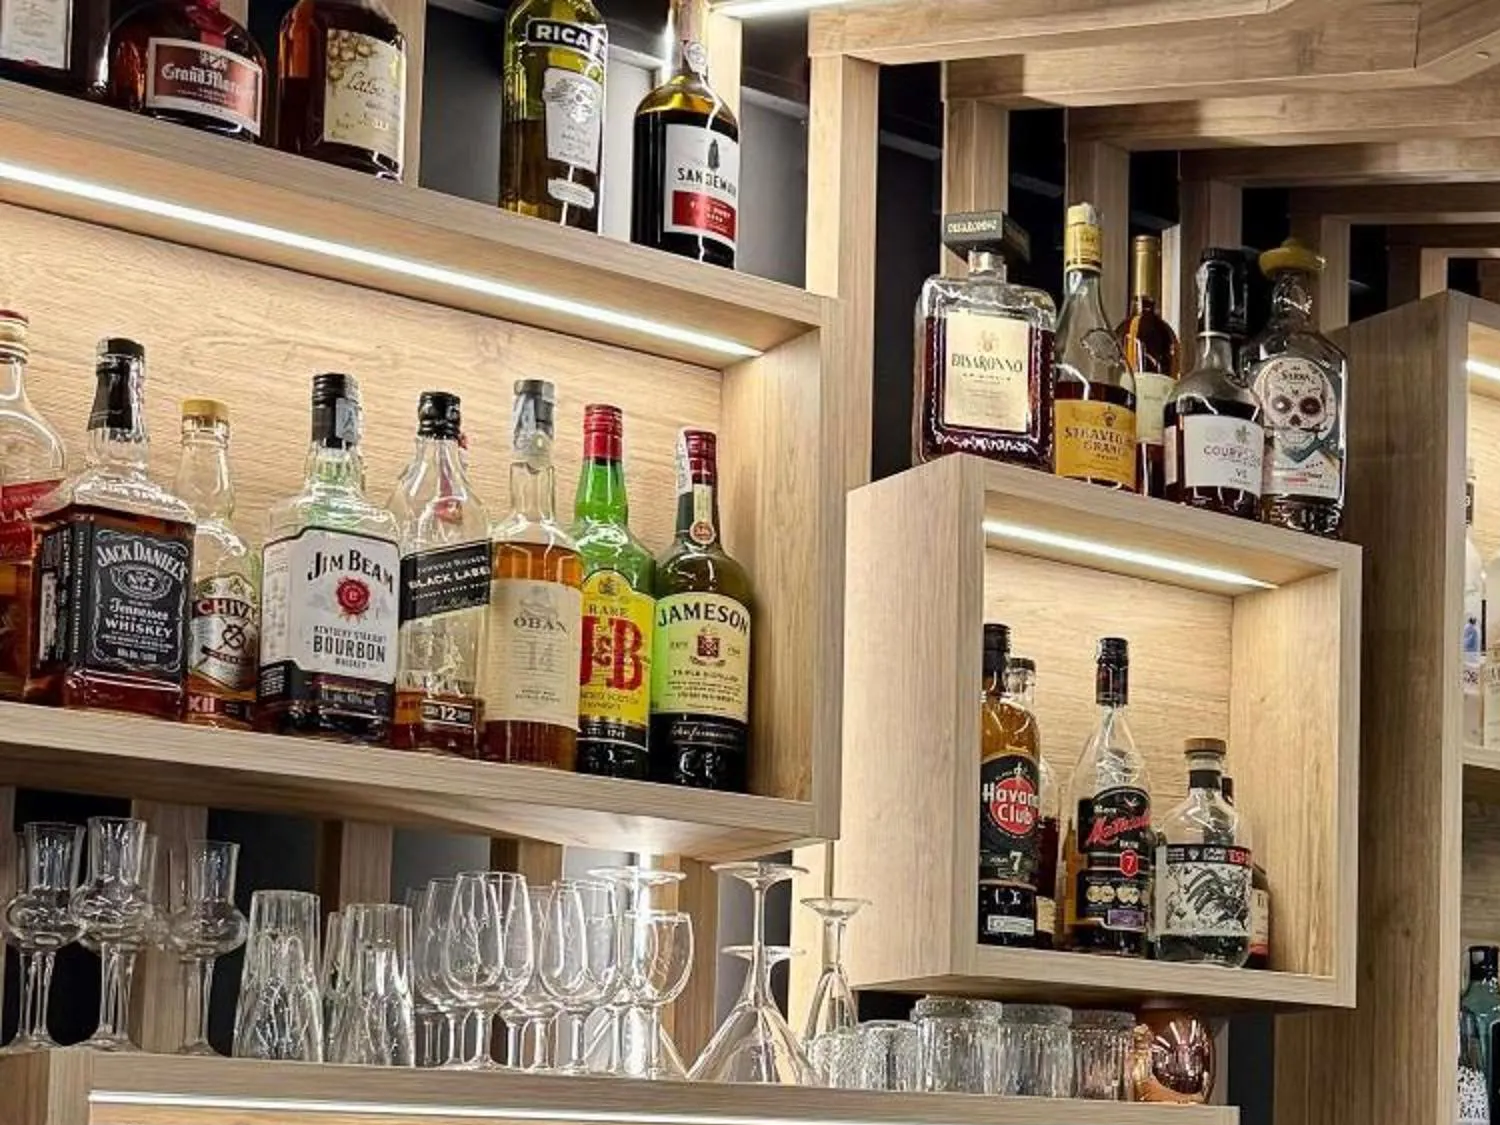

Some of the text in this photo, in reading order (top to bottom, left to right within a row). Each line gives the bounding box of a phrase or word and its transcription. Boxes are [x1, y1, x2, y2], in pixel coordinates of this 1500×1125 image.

[951, 353, 1023, 373] DISARONNO
[96, 544, 133, 568] JACK
[307, 551, 344, 582] JIM
[349, 549, 394, 595] BEAM
[104, 617, 173, 638] WHISKEY
[513, 617, 567, 633] OBAN
[657, 602, 749, 636] JAMESON
[313, 635, 386, 663] BOURBON
[440, 705, 457, 720] 12
[998, 803, 1033, 824] Club
[1009, 851, 1022, 873] 7
